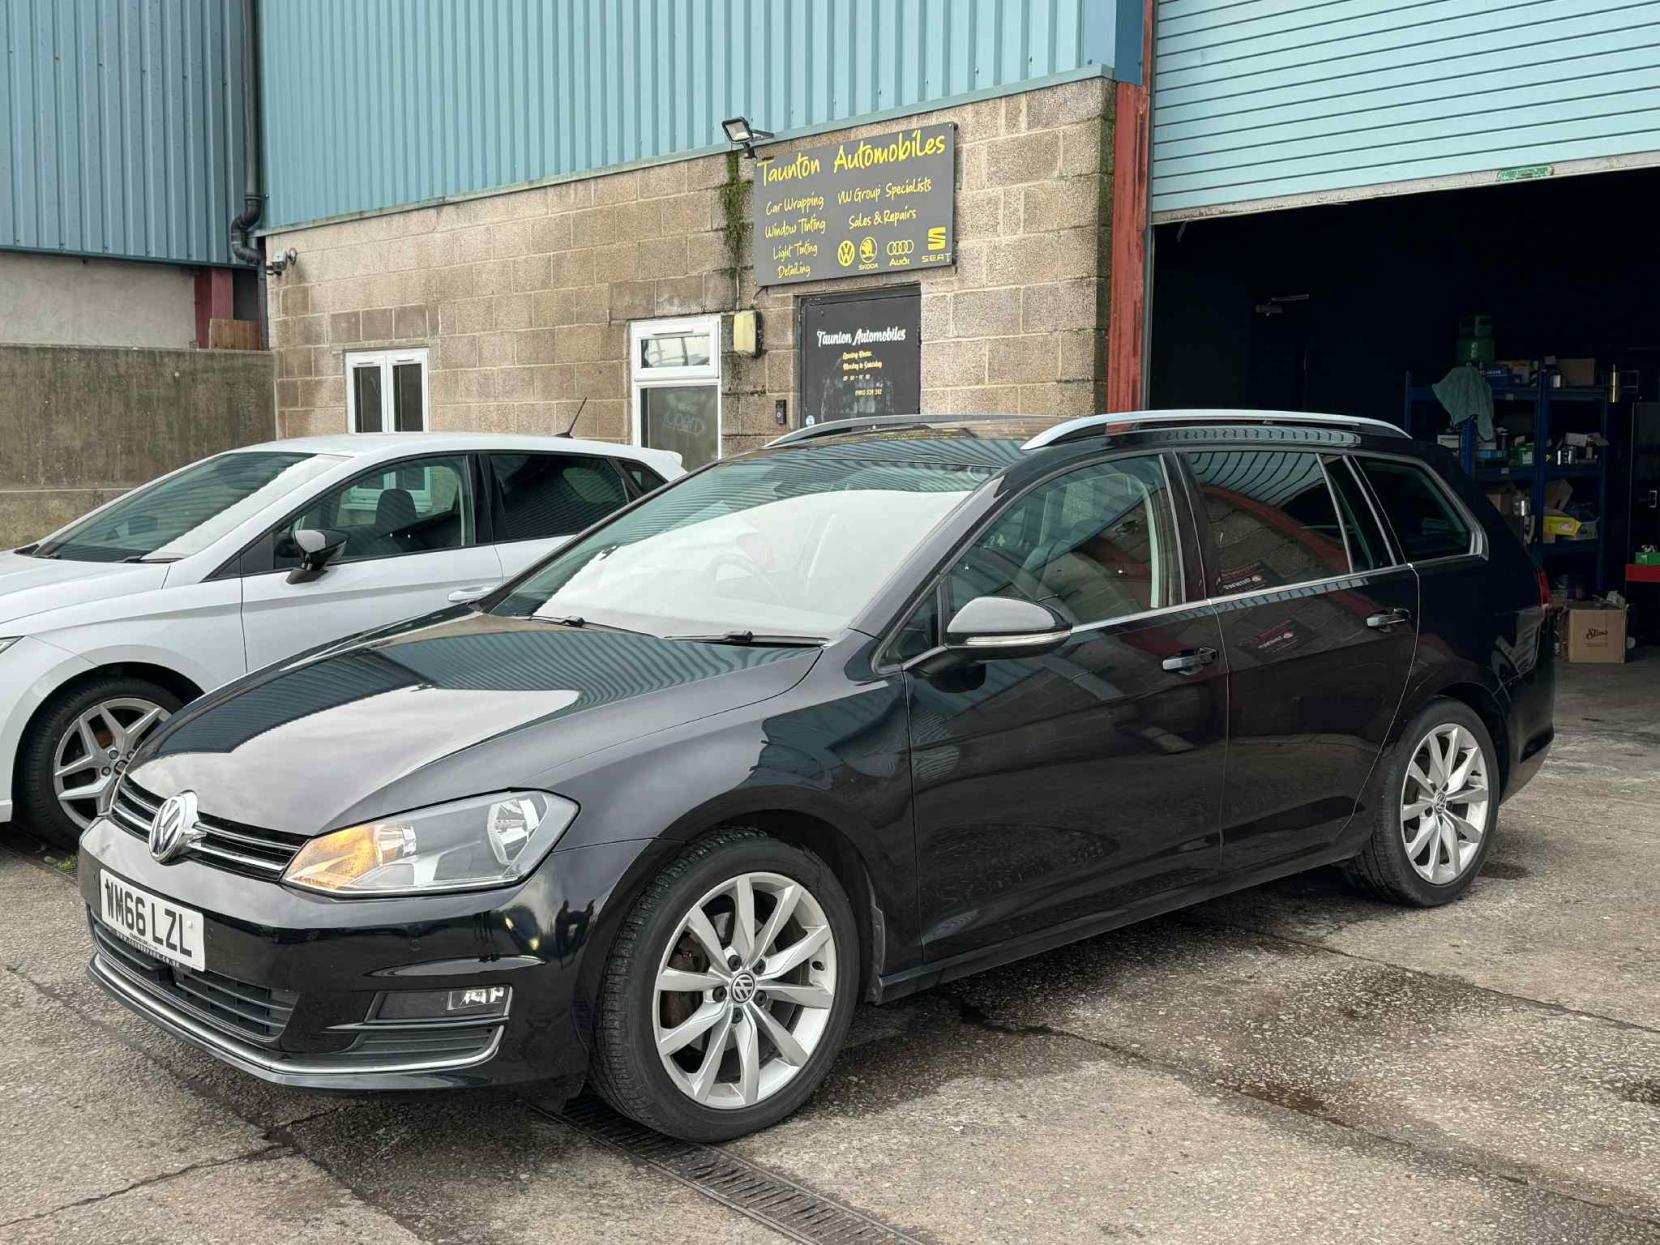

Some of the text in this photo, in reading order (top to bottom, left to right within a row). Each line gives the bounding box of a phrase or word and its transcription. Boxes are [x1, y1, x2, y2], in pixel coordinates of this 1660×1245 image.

[757, 130, 945, 186] Taunton Automobiles
[838, 176, 932, 205] VW Group Specialists
[766, 192, 825, 216] Car Wrapping
[765, 214, 826, 239] Window Tinting
[848, 212, 872, 230] Sales
[884, 206, 917, 224] Repairs
[773, 240, 818, 262] Light Tinting
[889, 256, 911, 267] Audi
[921, 252, 952, 263] SEAT
[777, 262, 811, 279] Detailing
[816, 326, 906, 347] Taunton Automobiles
[104, 878, 147, 937] WM66
[151, 901, 193, 959] LZL
